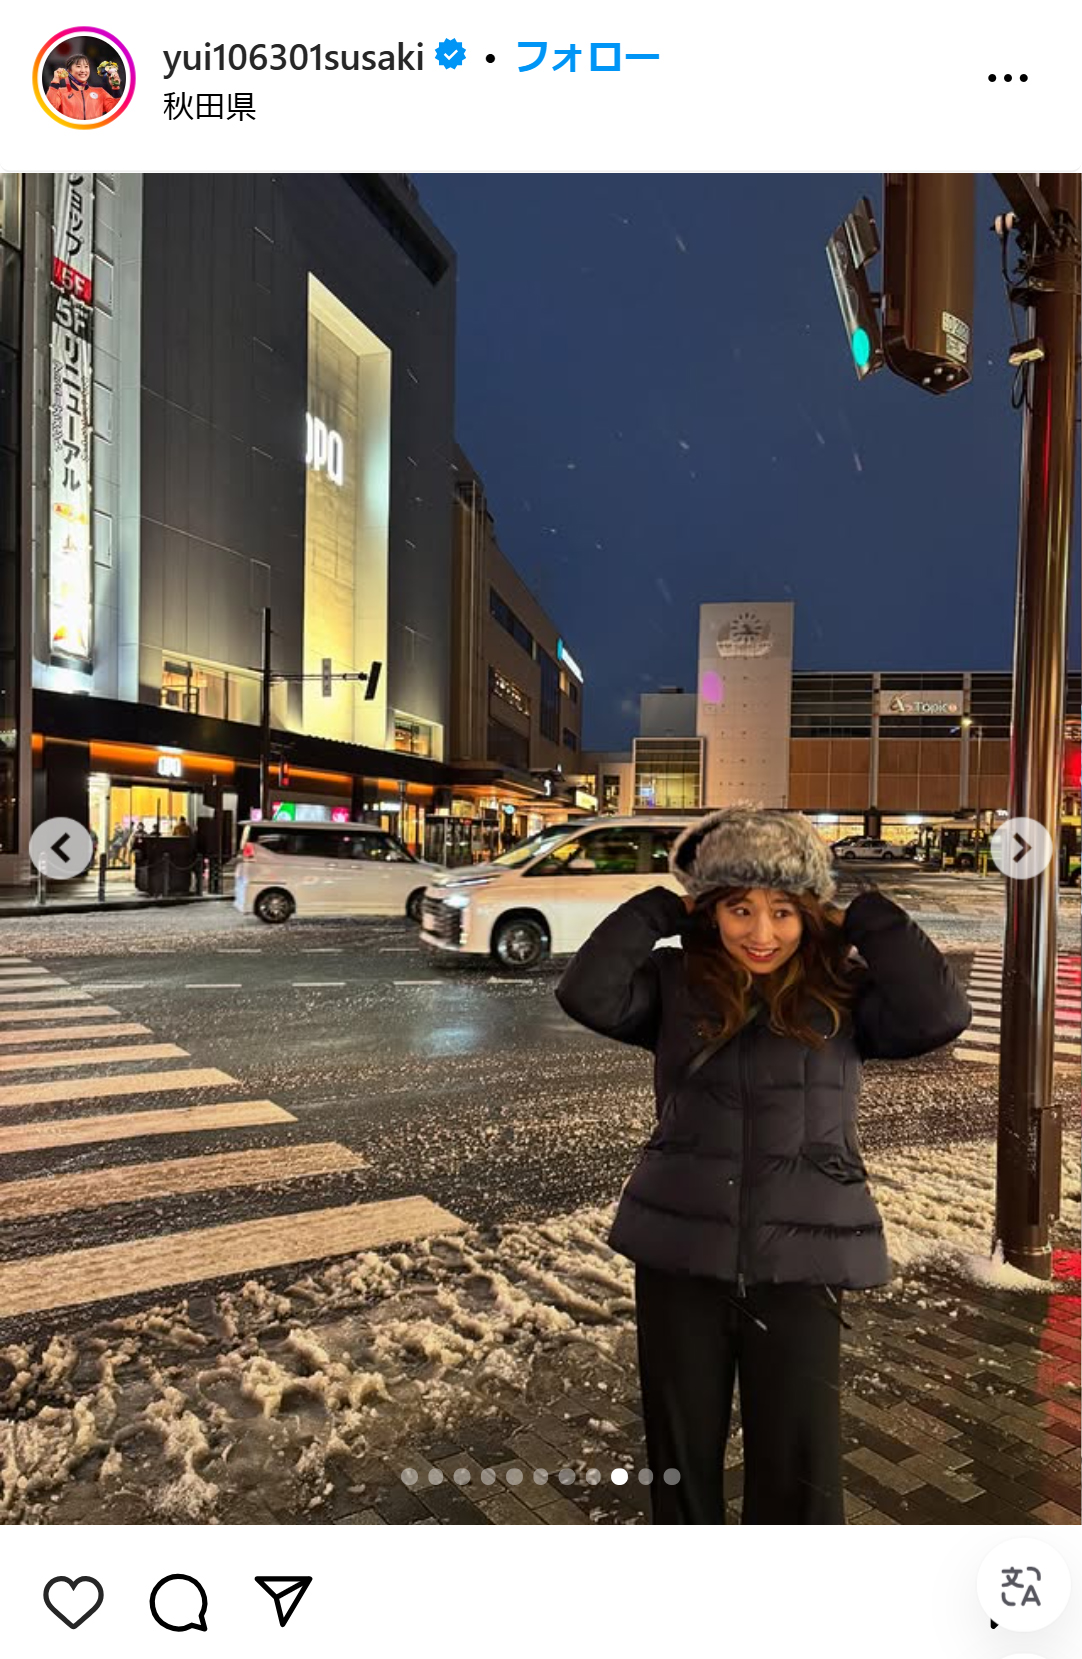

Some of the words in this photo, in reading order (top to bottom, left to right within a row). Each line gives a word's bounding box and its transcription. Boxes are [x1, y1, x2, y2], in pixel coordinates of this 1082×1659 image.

[62, 335, 82, 492] リニューアル
